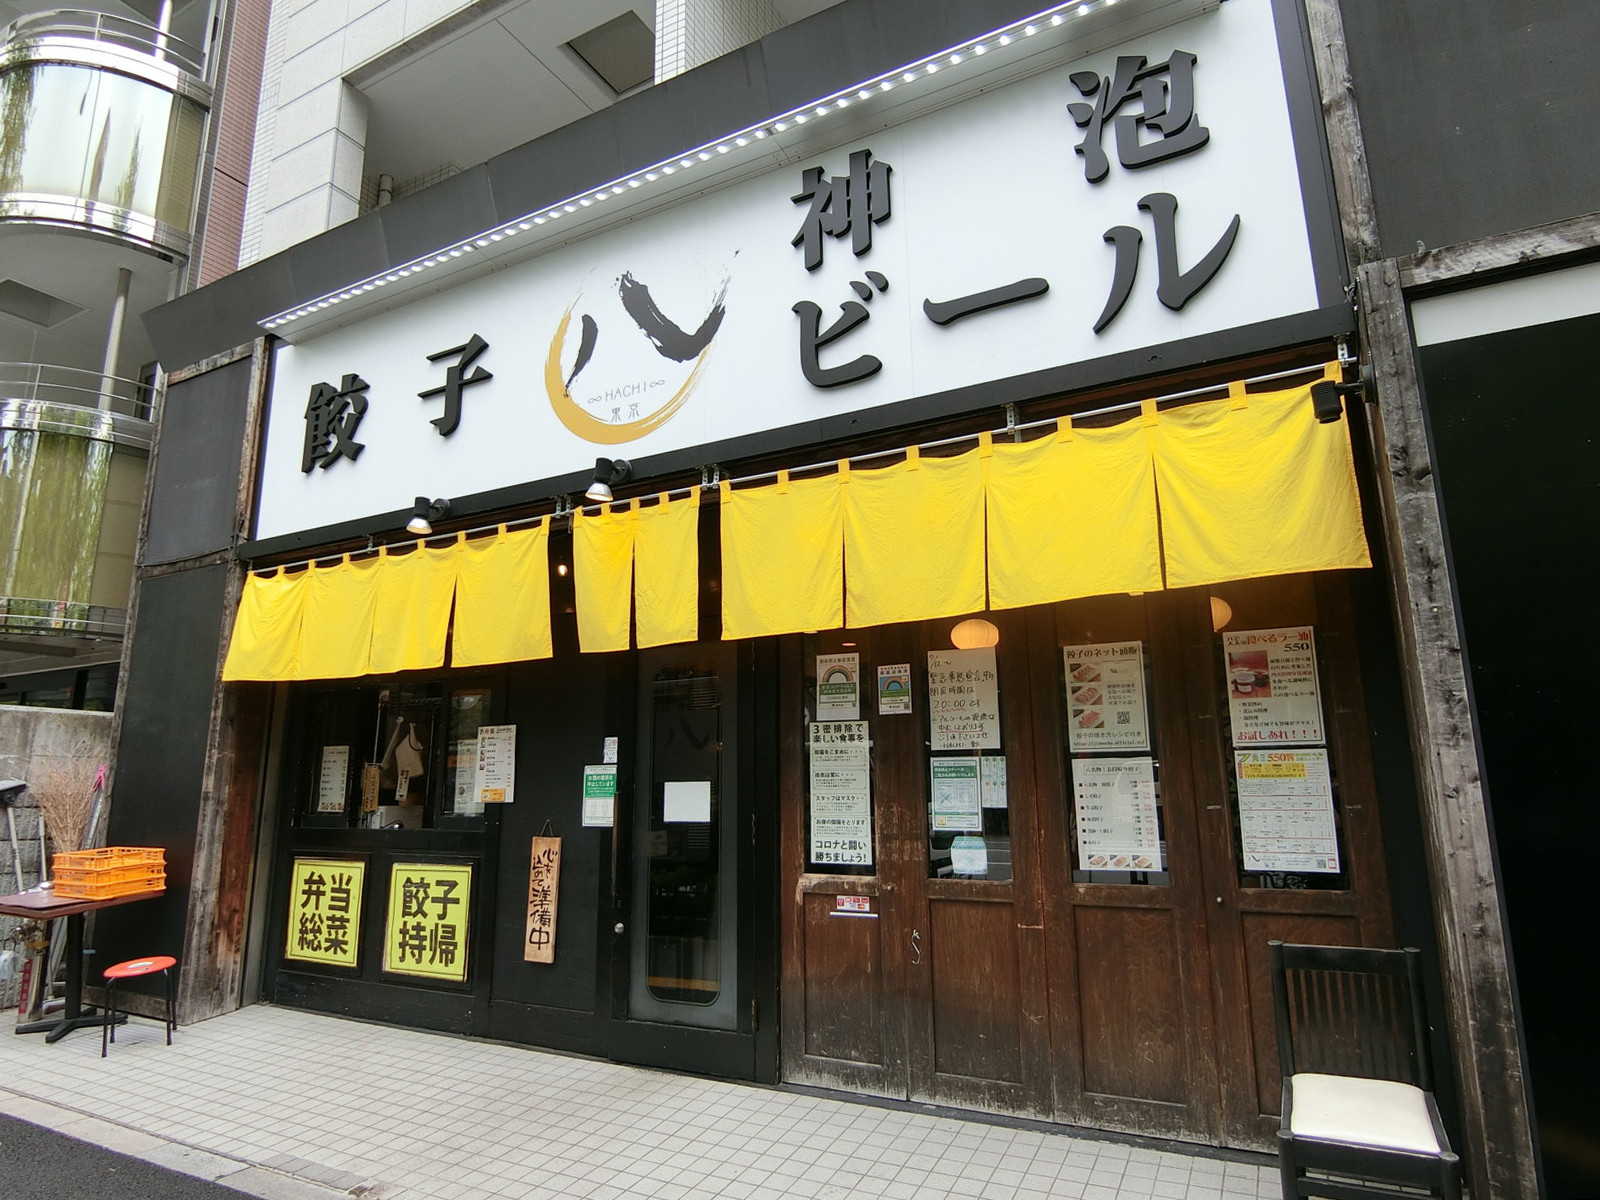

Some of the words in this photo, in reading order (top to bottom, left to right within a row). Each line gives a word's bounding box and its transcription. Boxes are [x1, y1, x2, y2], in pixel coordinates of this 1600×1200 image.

[791, 193, 1241, 388] ビール
[604, 380, 647, 402] HACHI
[301, 333, 494, 474] 餃子
[609, 402, 640, 423] 東京
[1067, 646, 1138, 659] 餃子のネット通販
[1284, 642, 1310, 652] 550
[933, 699, 966, 709] 20:00
[813, 733, 865, 743] 楽しい食事を
[1076, 731, 1142, 739] 餃子の焼き方レシピ付き
[814, 840, 867, 850] コロナと闘い
[301, 871, 353, 914] 弁当
[402, 876, 460, 920] 餃子
[530, 885, 553, 951] 準備中
[298, 912, 350, 955] 総菜
[398, 920, 458, 968] 持帰
